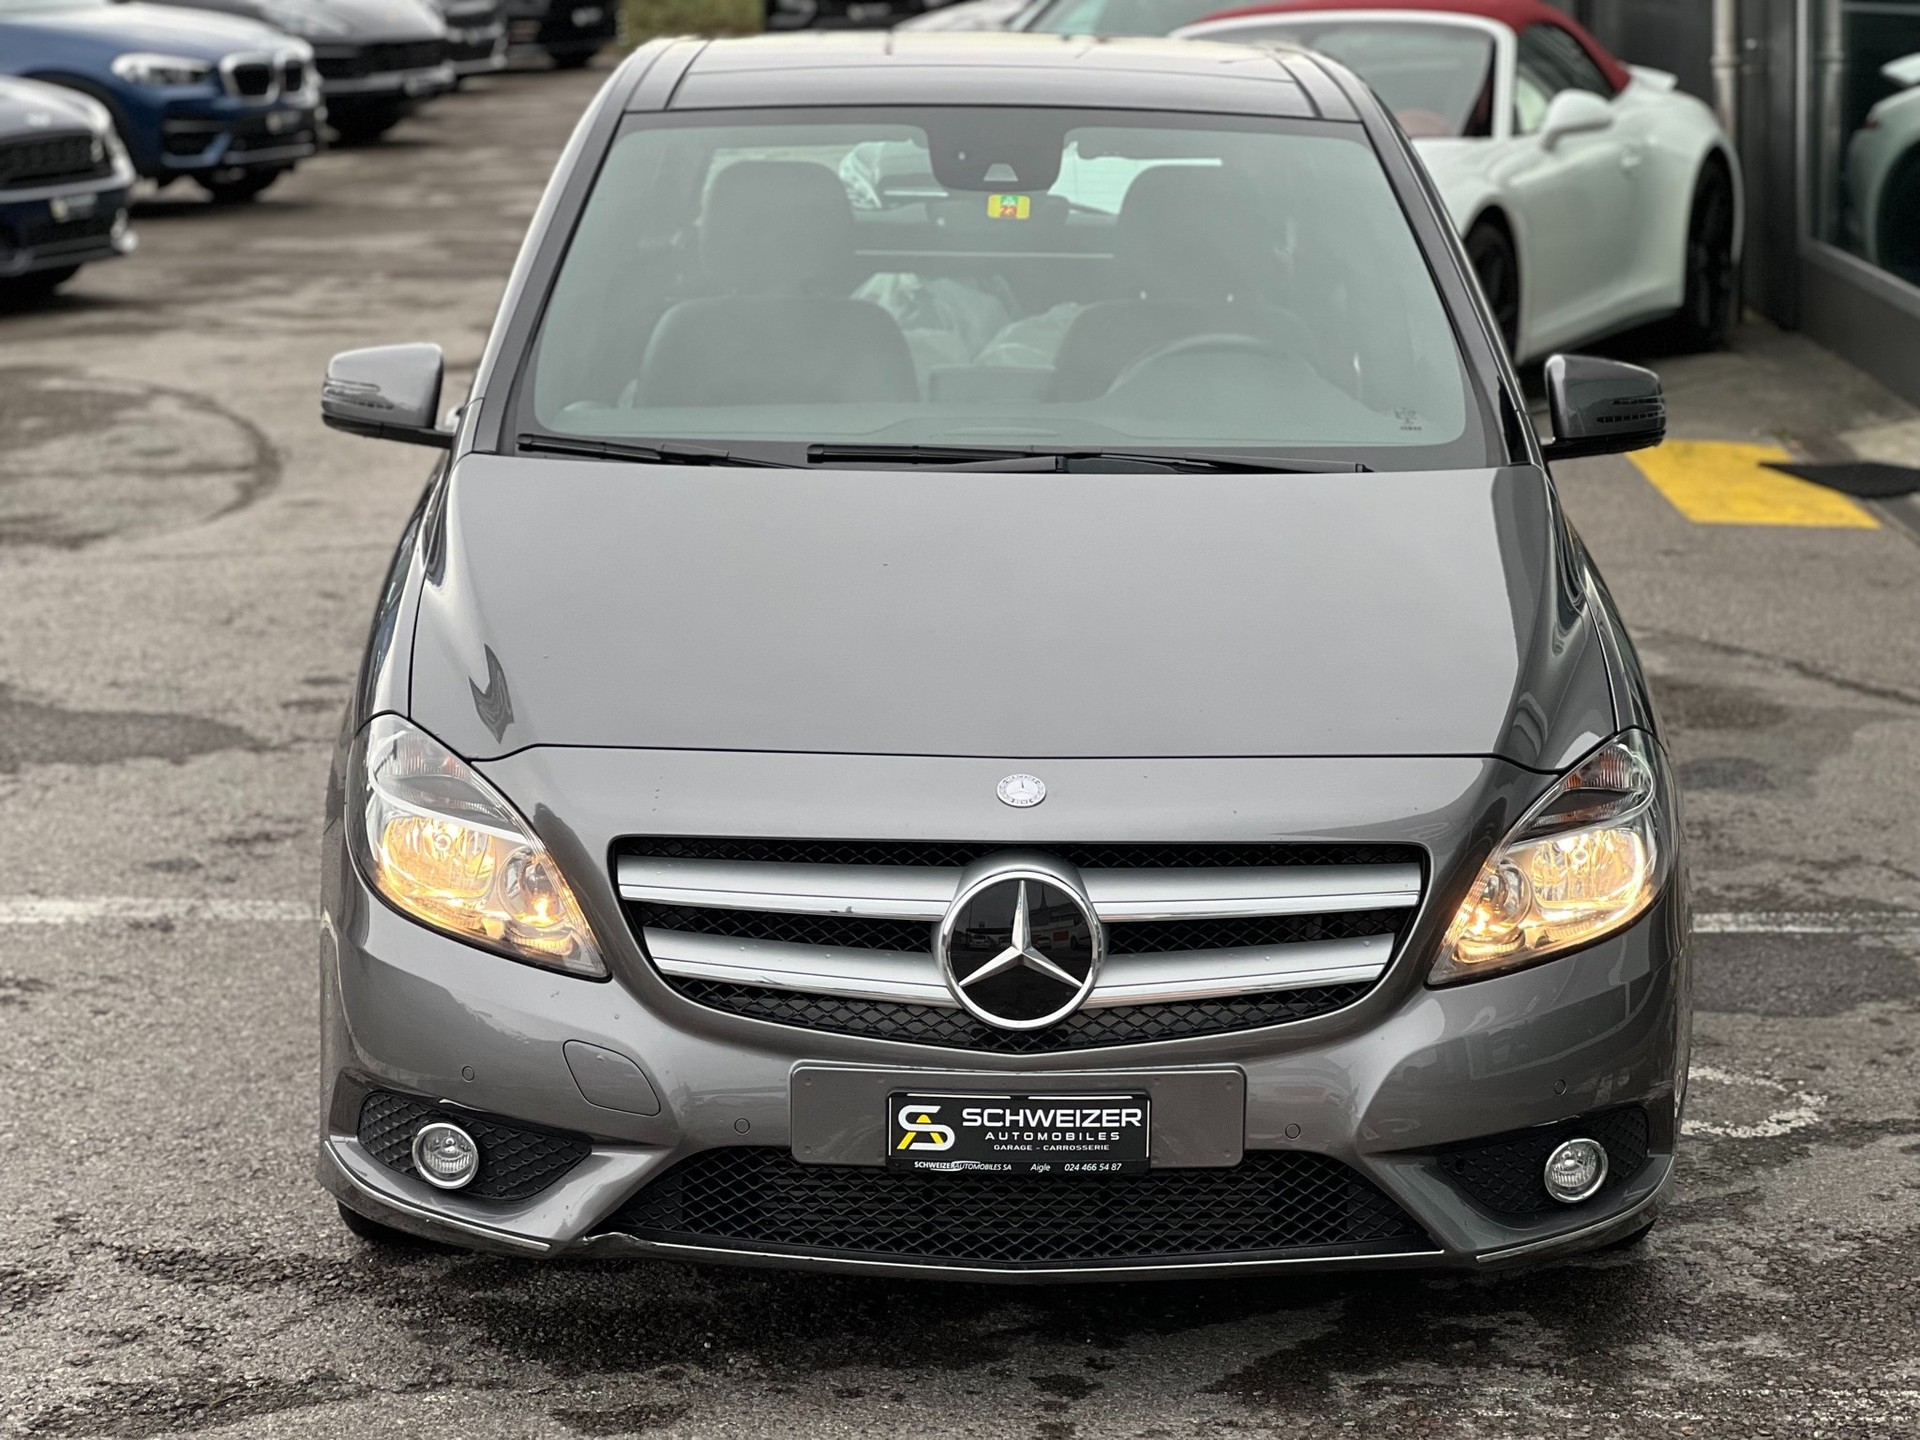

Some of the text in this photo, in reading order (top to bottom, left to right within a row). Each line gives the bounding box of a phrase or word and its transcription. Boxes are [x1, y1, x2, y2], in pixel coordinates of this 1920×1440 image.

[962, 1108, 1142, 1127] SCHWEIZER
[985, 1131, 1120, 1141] AUTOMOBILES
[1003, 1163, 1012, 1171] SA
[1030, 1163, 1051, 1173] Aigle
[1064, 1163, 1080, 1171] 024
[1081, 1163, 1097, 1171] 466
[1099, 1163, 1110, 1171] 54
[1111, 1163, 1122, 1171] 87
